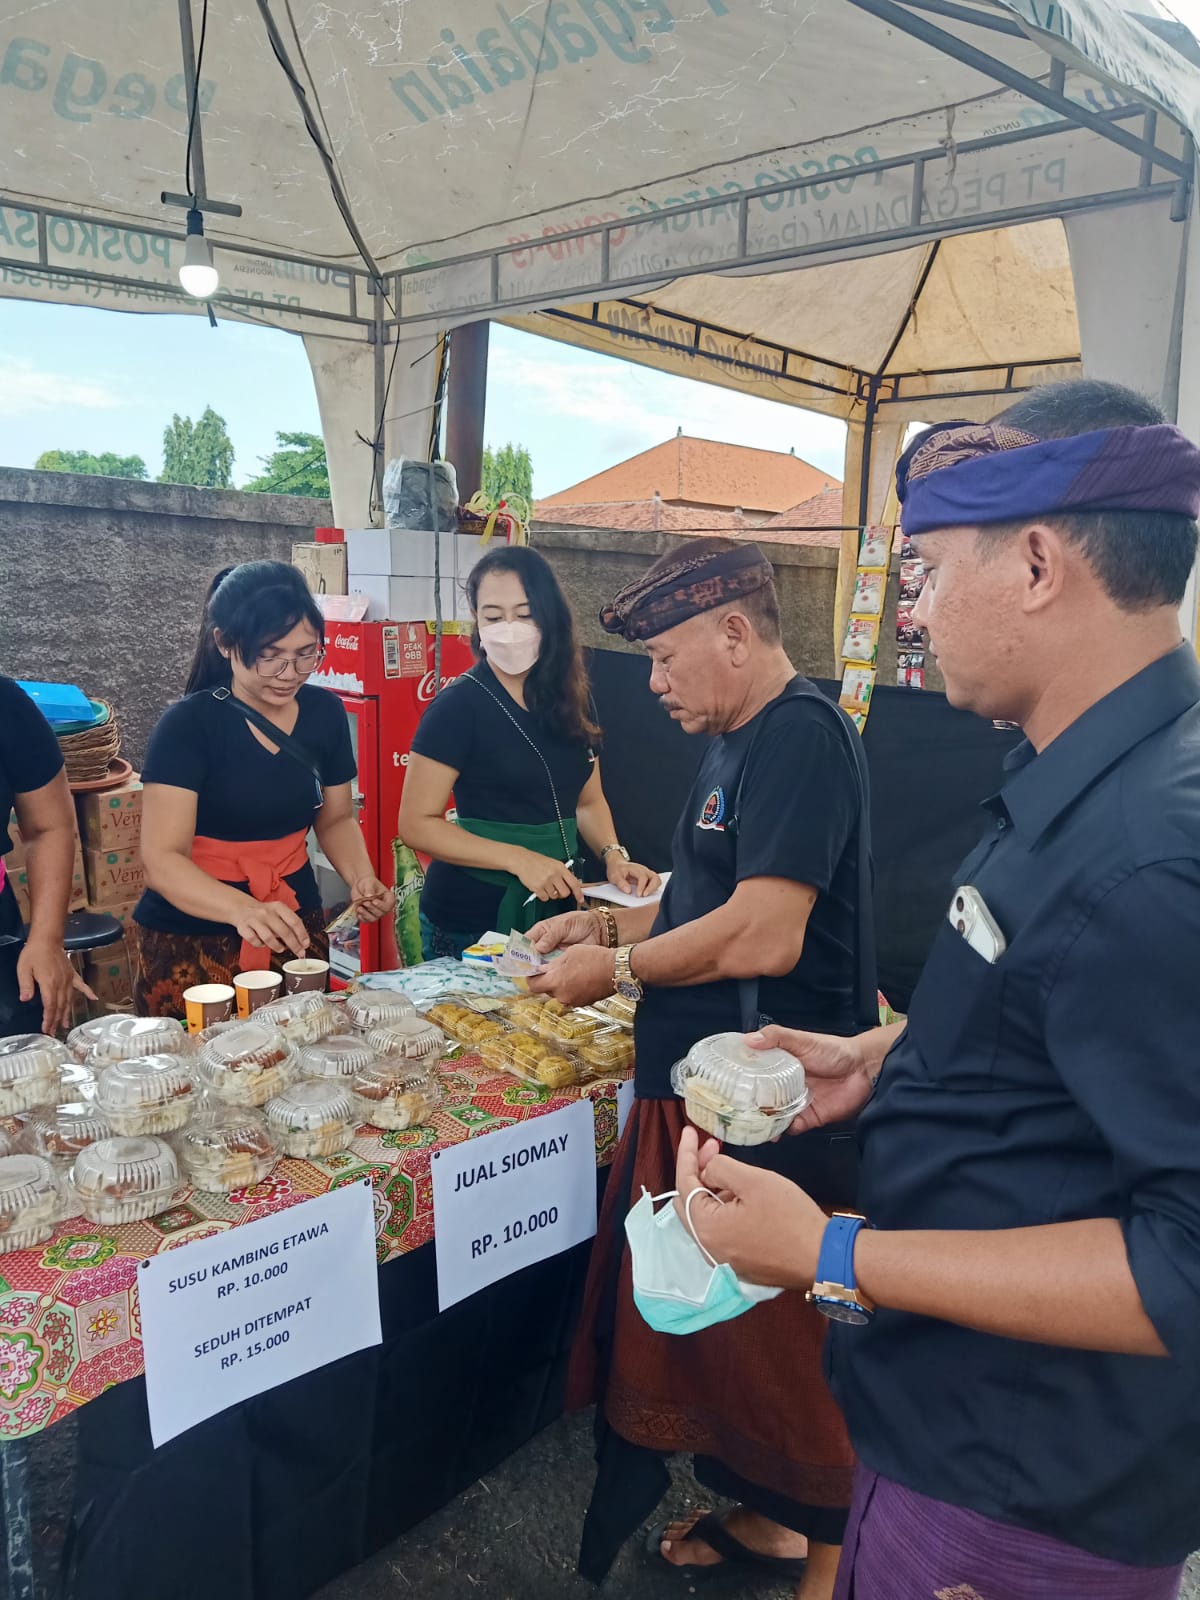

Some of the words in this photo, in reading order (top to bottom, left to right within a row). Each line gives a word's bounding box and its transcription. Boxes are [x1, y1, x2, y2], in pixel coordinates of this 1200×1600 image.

[453, 1161, 499, 1193] JUAL
[501, 1134, 570, 1174] SIOMAY
[168, 1267, 208, 1294] SUSU
[211, 1241, 280, 1278] KAMBING
[282, 1222, 329, 1251] ETAWA
[470, 1233, 499, 1259] RP.
[503, 1206, 559, 1244] 10.000
[216, 1280, 239, 1300] RP.
[243, 1261, 289, 1289] 10.000
[193, 1326, 241, 1359] SEDUH
[244, 1297, 313, 1336] DITEMPAT
[220, 1352, 243, 1371] RP.
[246, 1330, 291, 1360] 15.000
